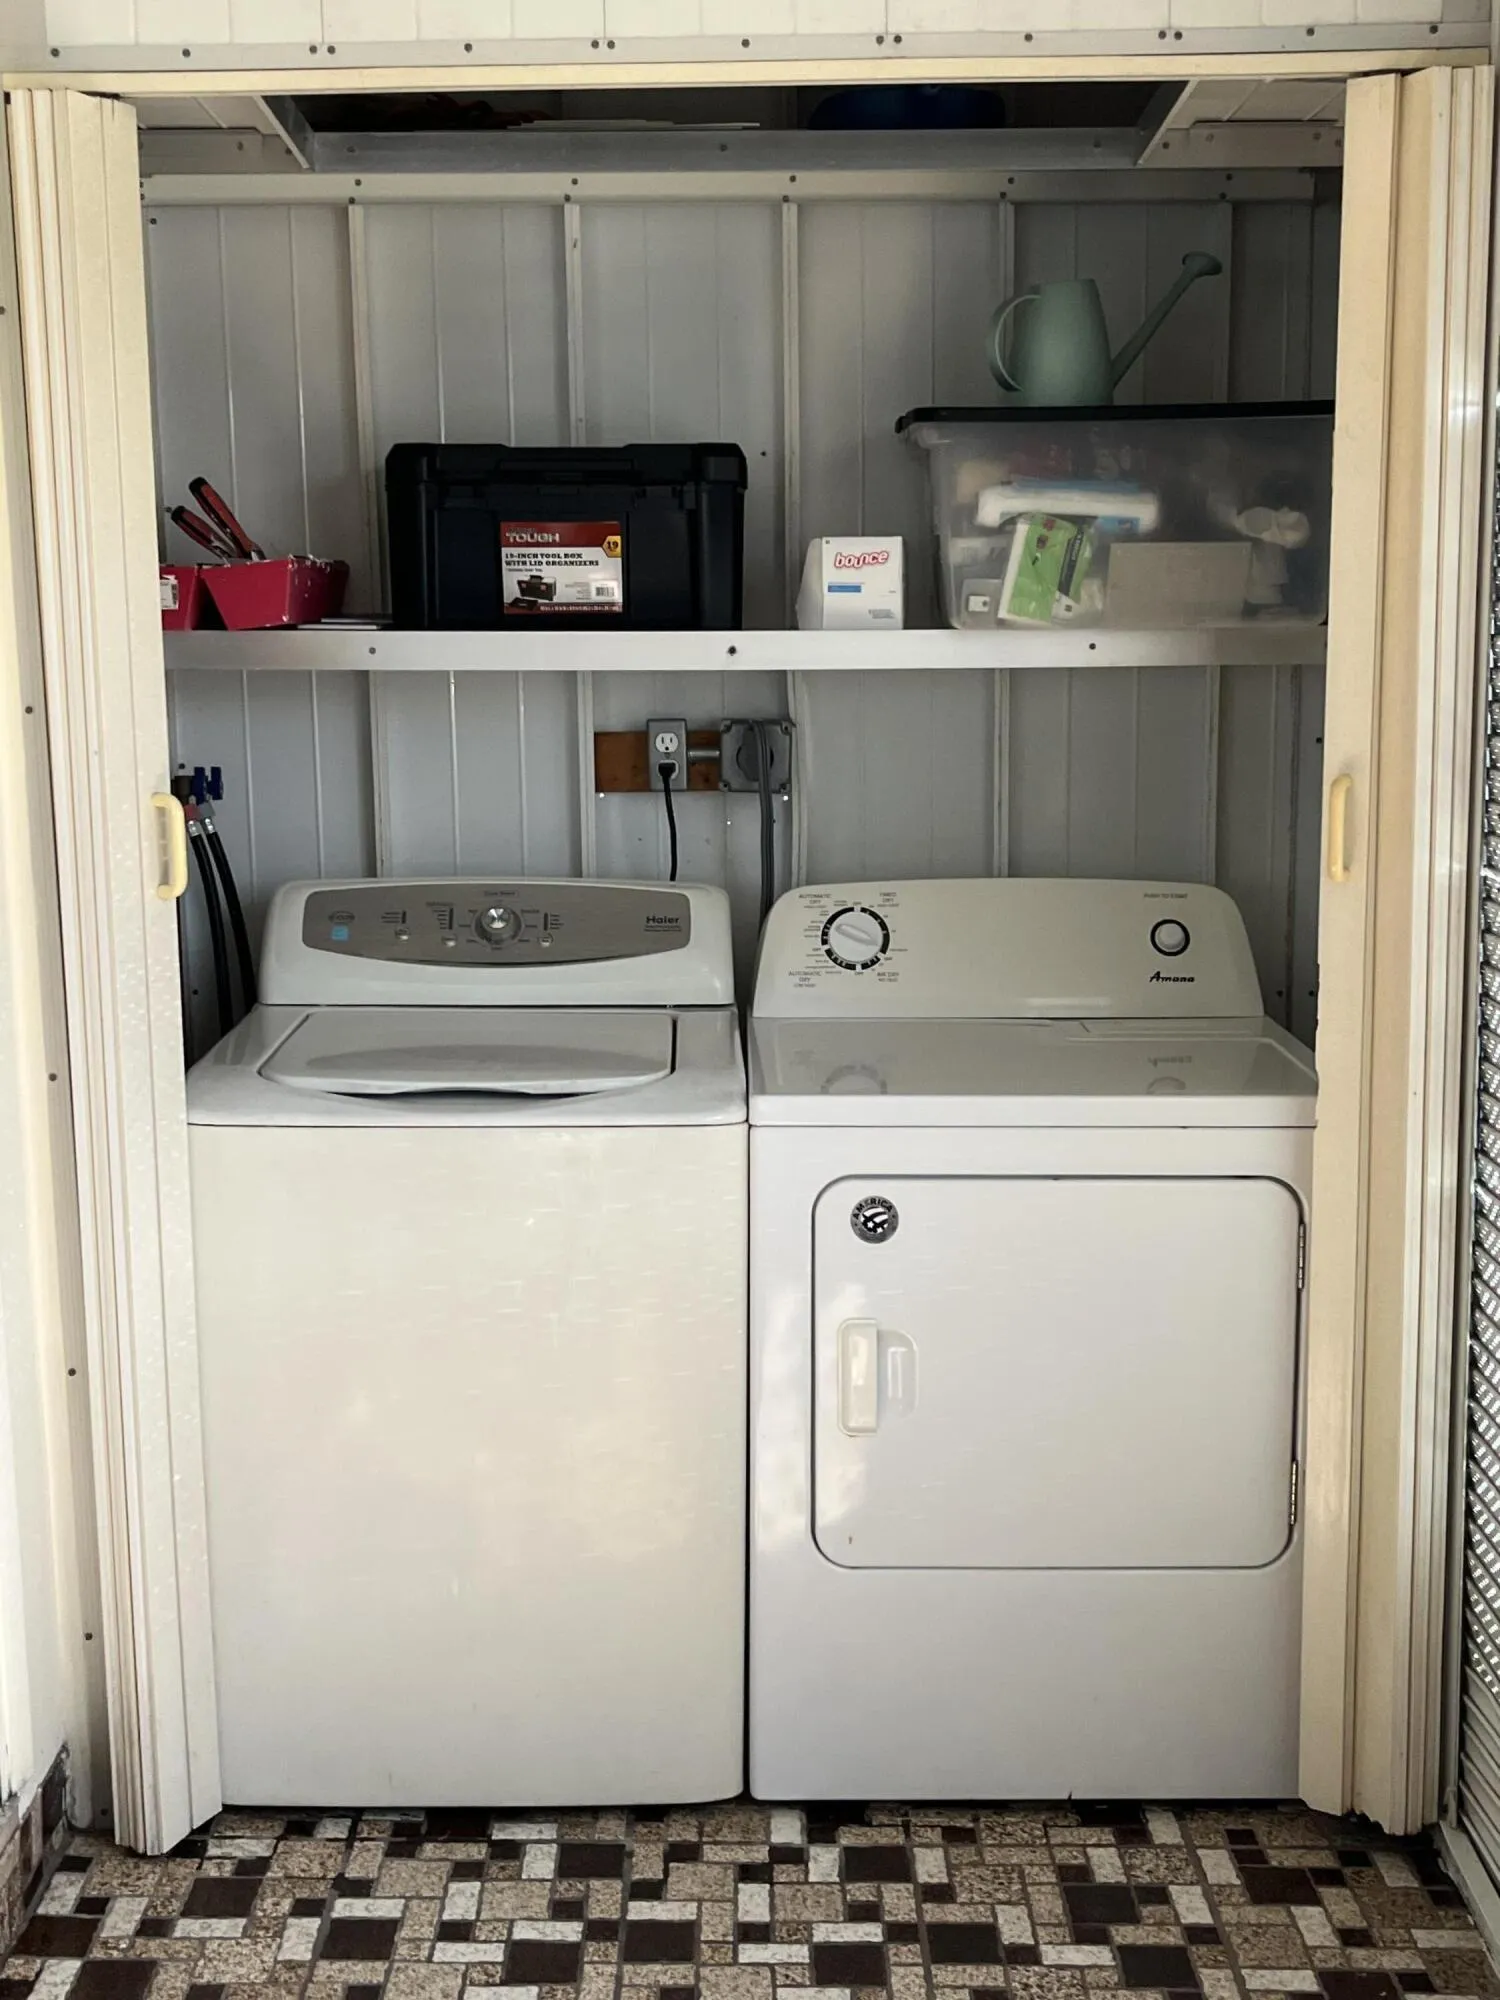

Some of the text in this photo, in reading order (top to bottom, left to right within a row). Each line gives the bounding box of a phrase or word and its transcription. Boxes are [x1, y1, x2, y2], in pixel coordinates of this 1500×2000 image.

[506, 532, 560, 543] TOUGH
[606, 540, 619, 551] 19
[834, 551, 889, 569] bounce
[645, 916, 680, 925] Haier
[1149, 971, 1196, 983] Amana
